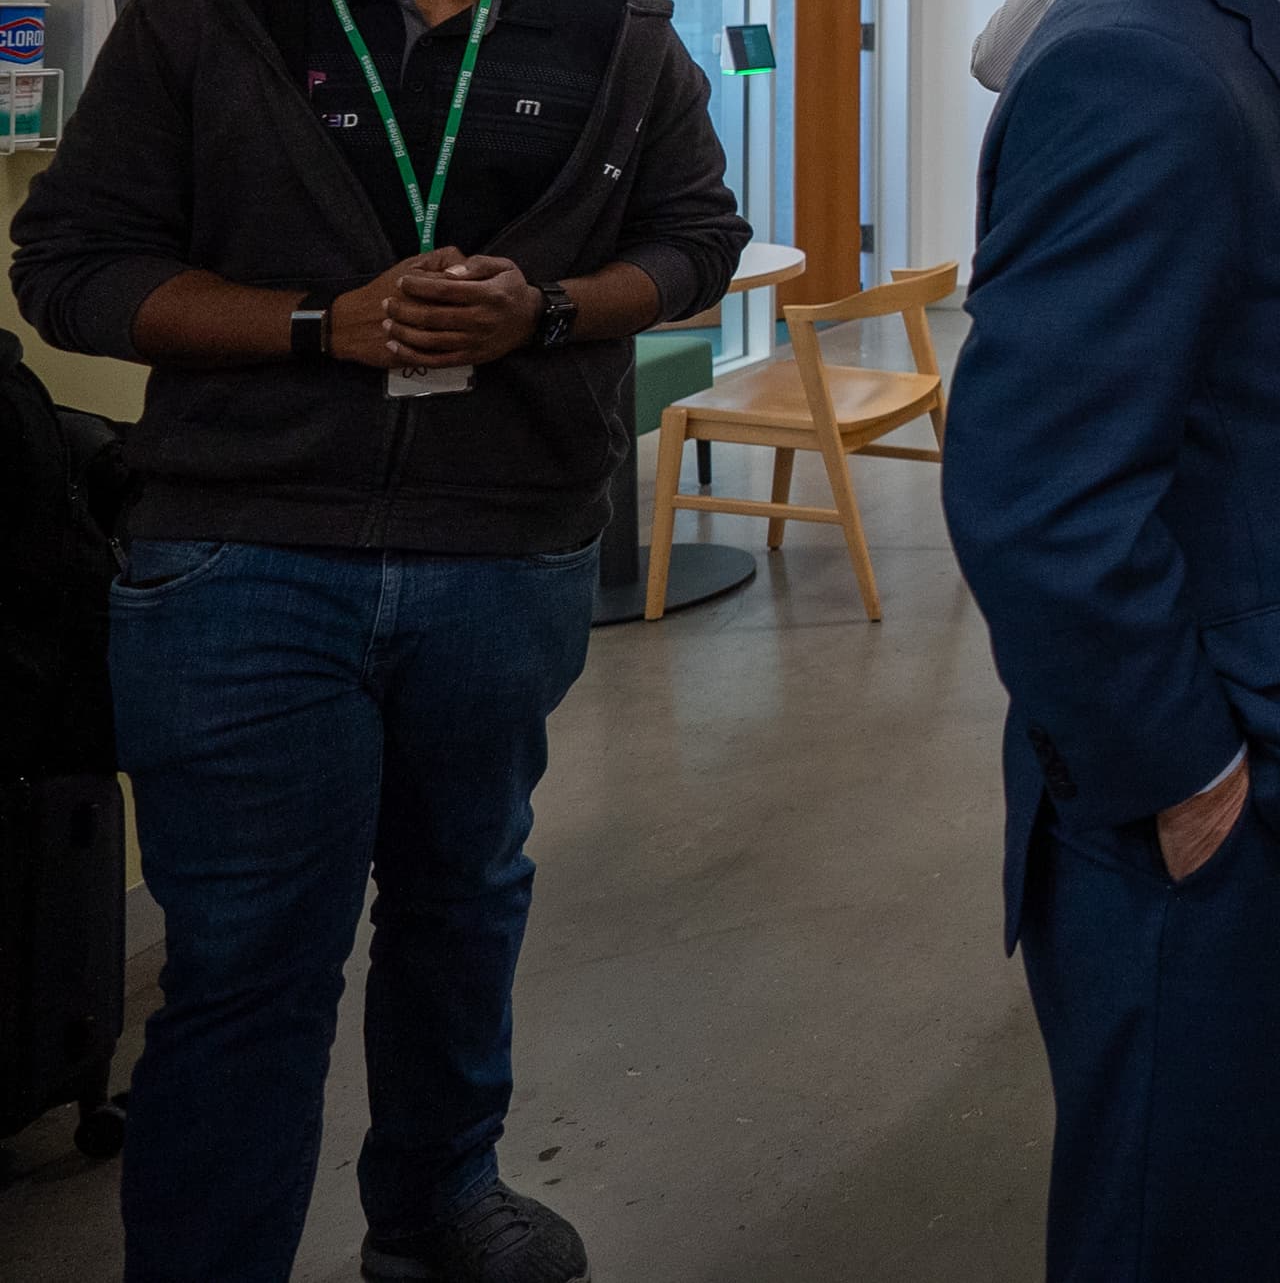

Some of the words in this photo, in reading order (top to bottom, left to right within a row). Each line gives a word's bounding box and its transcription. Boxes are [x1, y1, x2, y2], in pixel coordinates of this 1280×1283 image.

[470, 8, 489, 44] Business
[360, 54, 382, 93] Business
[453, 70, 472, 109] Business
[386, 117, 405, 158] Business
[435, 136, 456, 175] Business
[408, 183, 425, 222] Business
[422, 203, 439, 244] Business
